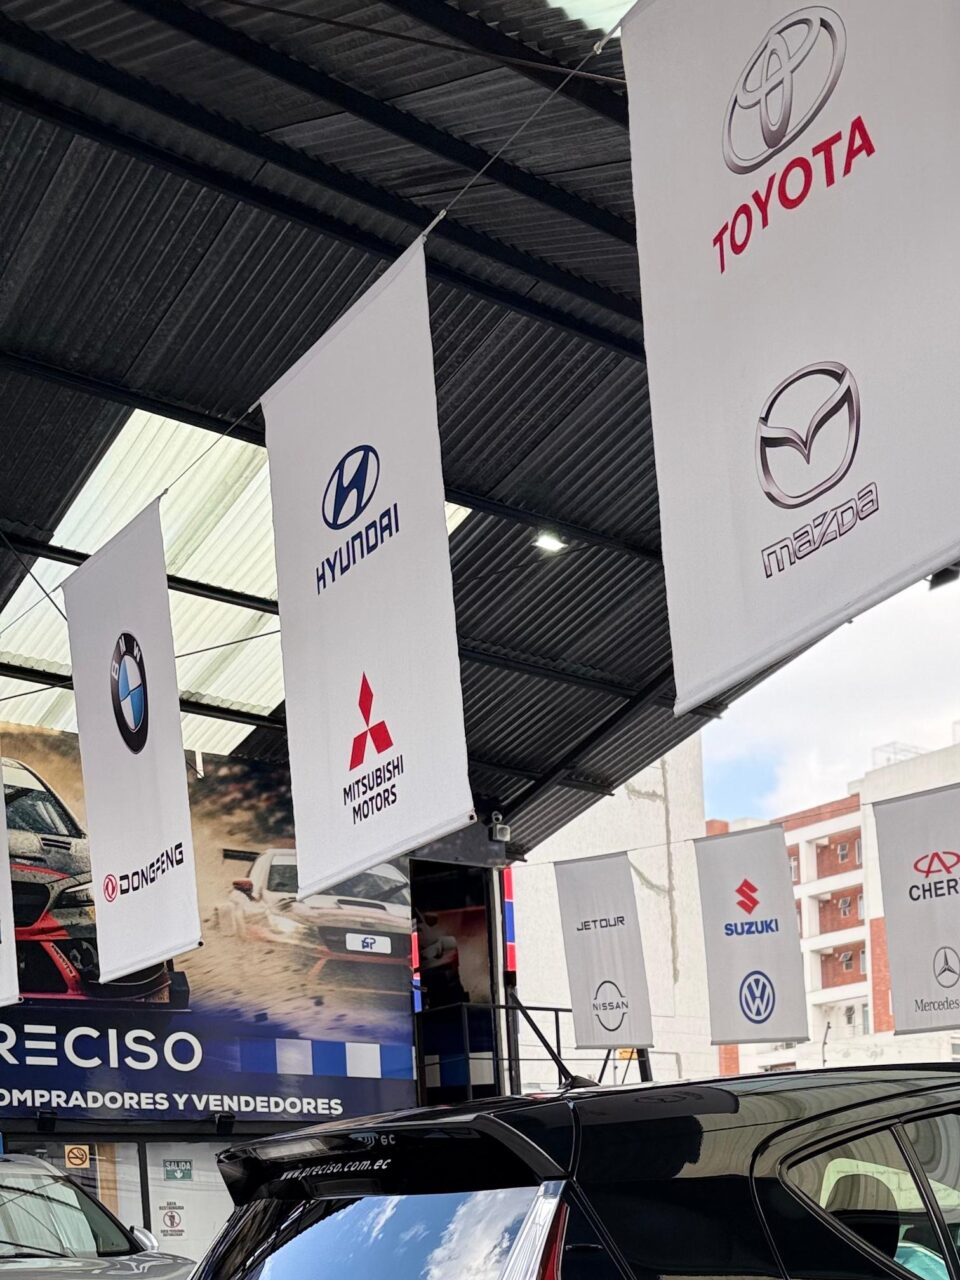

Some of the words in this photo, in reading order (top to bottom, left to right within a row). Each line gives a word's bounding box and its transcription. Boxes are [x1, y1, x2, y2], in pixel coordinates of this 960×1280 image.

[712, 115, 876, 274] TOYOTA
[316, 503, 400, 595] HYUNDAI
[343, 754, 404, 806] MITSUBISHI
[353, 787, 398, 825] MOTORS
[119, 842, 184, 895] DONGFENG
[576, 915, 625, 932] JETOUR
[724, 918, 779, 936] SUZUKI
[592, 1000, 629, 1011] NISSAN
[173, 1093, 190, 1110] Y
[191, 1094, 343, 1115] VENDEDORES
[166, 1161, 191, 1170] SALIDA
